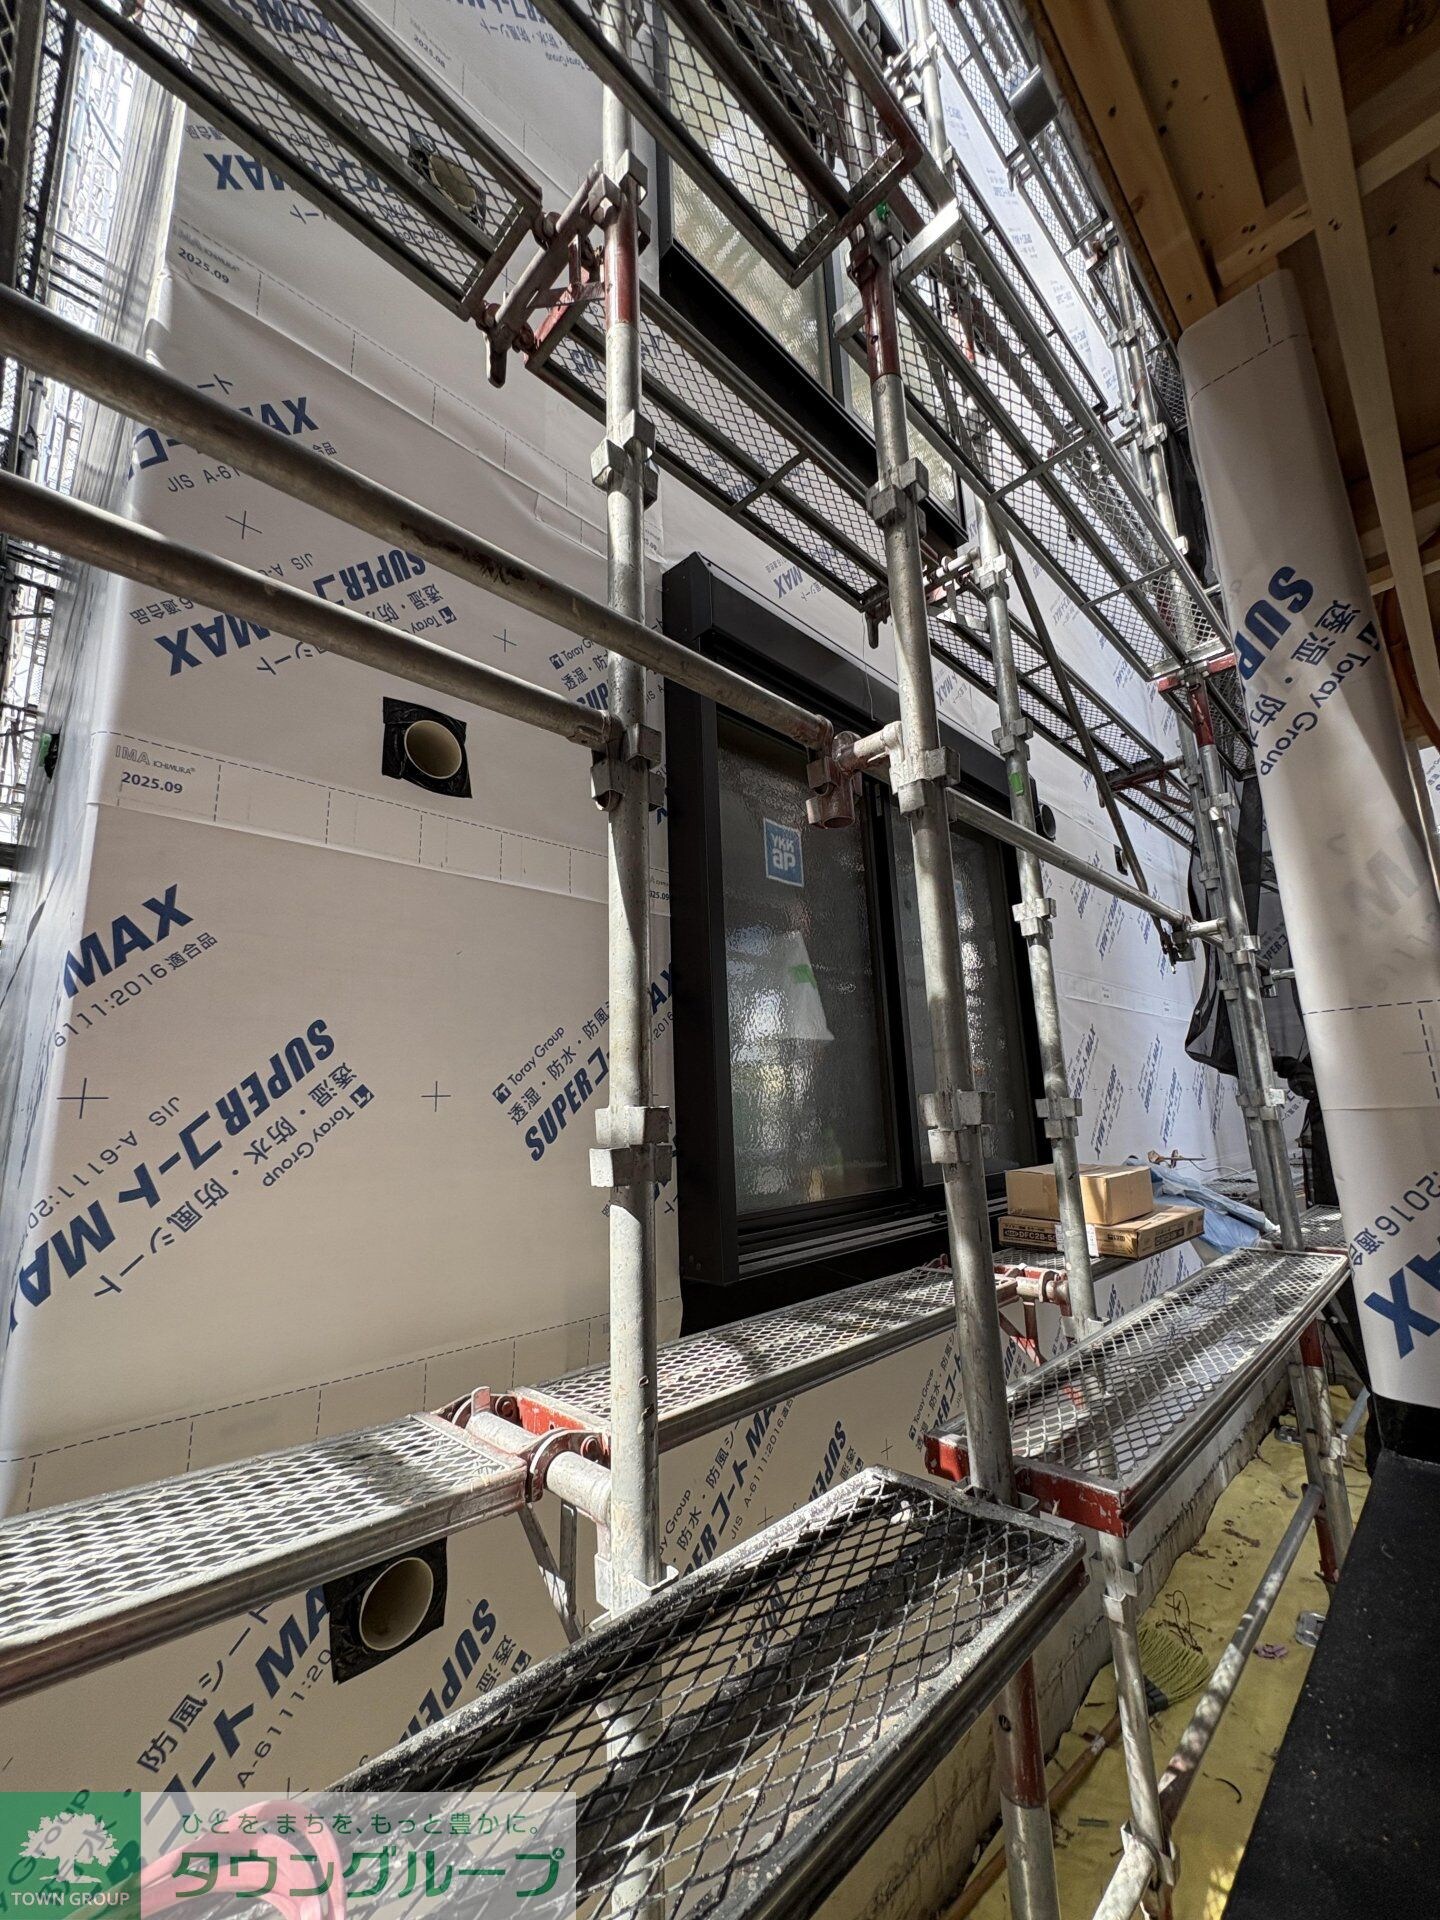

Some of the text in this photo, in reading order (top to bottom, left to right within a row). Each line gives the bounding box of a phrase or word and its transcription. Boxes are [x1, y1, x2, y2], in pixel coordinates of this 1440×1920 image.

[178, 247, 230, 284] 2025.09
[250, 397, 319, 435] AX
[168, 473, 195, 492] JIS
[257, 552, 313, 577] JIS A-
[129, 597, 194, 626] 6適合品
[411, 616, 444, 635] Toray
[1235, 566, 1314, 681] SUP
[562, 643, 584, 663] Toray
[1260, 652, 1371, 776] Toray Group
[121, 771, 183, 794] 2025.09
[770, 832, 795, 853] YKK
[772, 847, 796, 871] ap
[63, 884, 194, 998] MAX
[507, 1026, 565, 1087] Toray Group
[507, 1000, 610, 1126] 透湿・防水・防風
[149, 1096, 180, 1127] JIS
[524, 1046, 610, 1163] SUPERコ
[18, 1019, 335, 1308] SUPERコート MA
[262, 1105, 355, 1188] Toray Group
[665, 1489, 691, 1535] Group
[731, 1515, 743, 1540] JIS
[400, 1598, 497, 1743] SUPE
